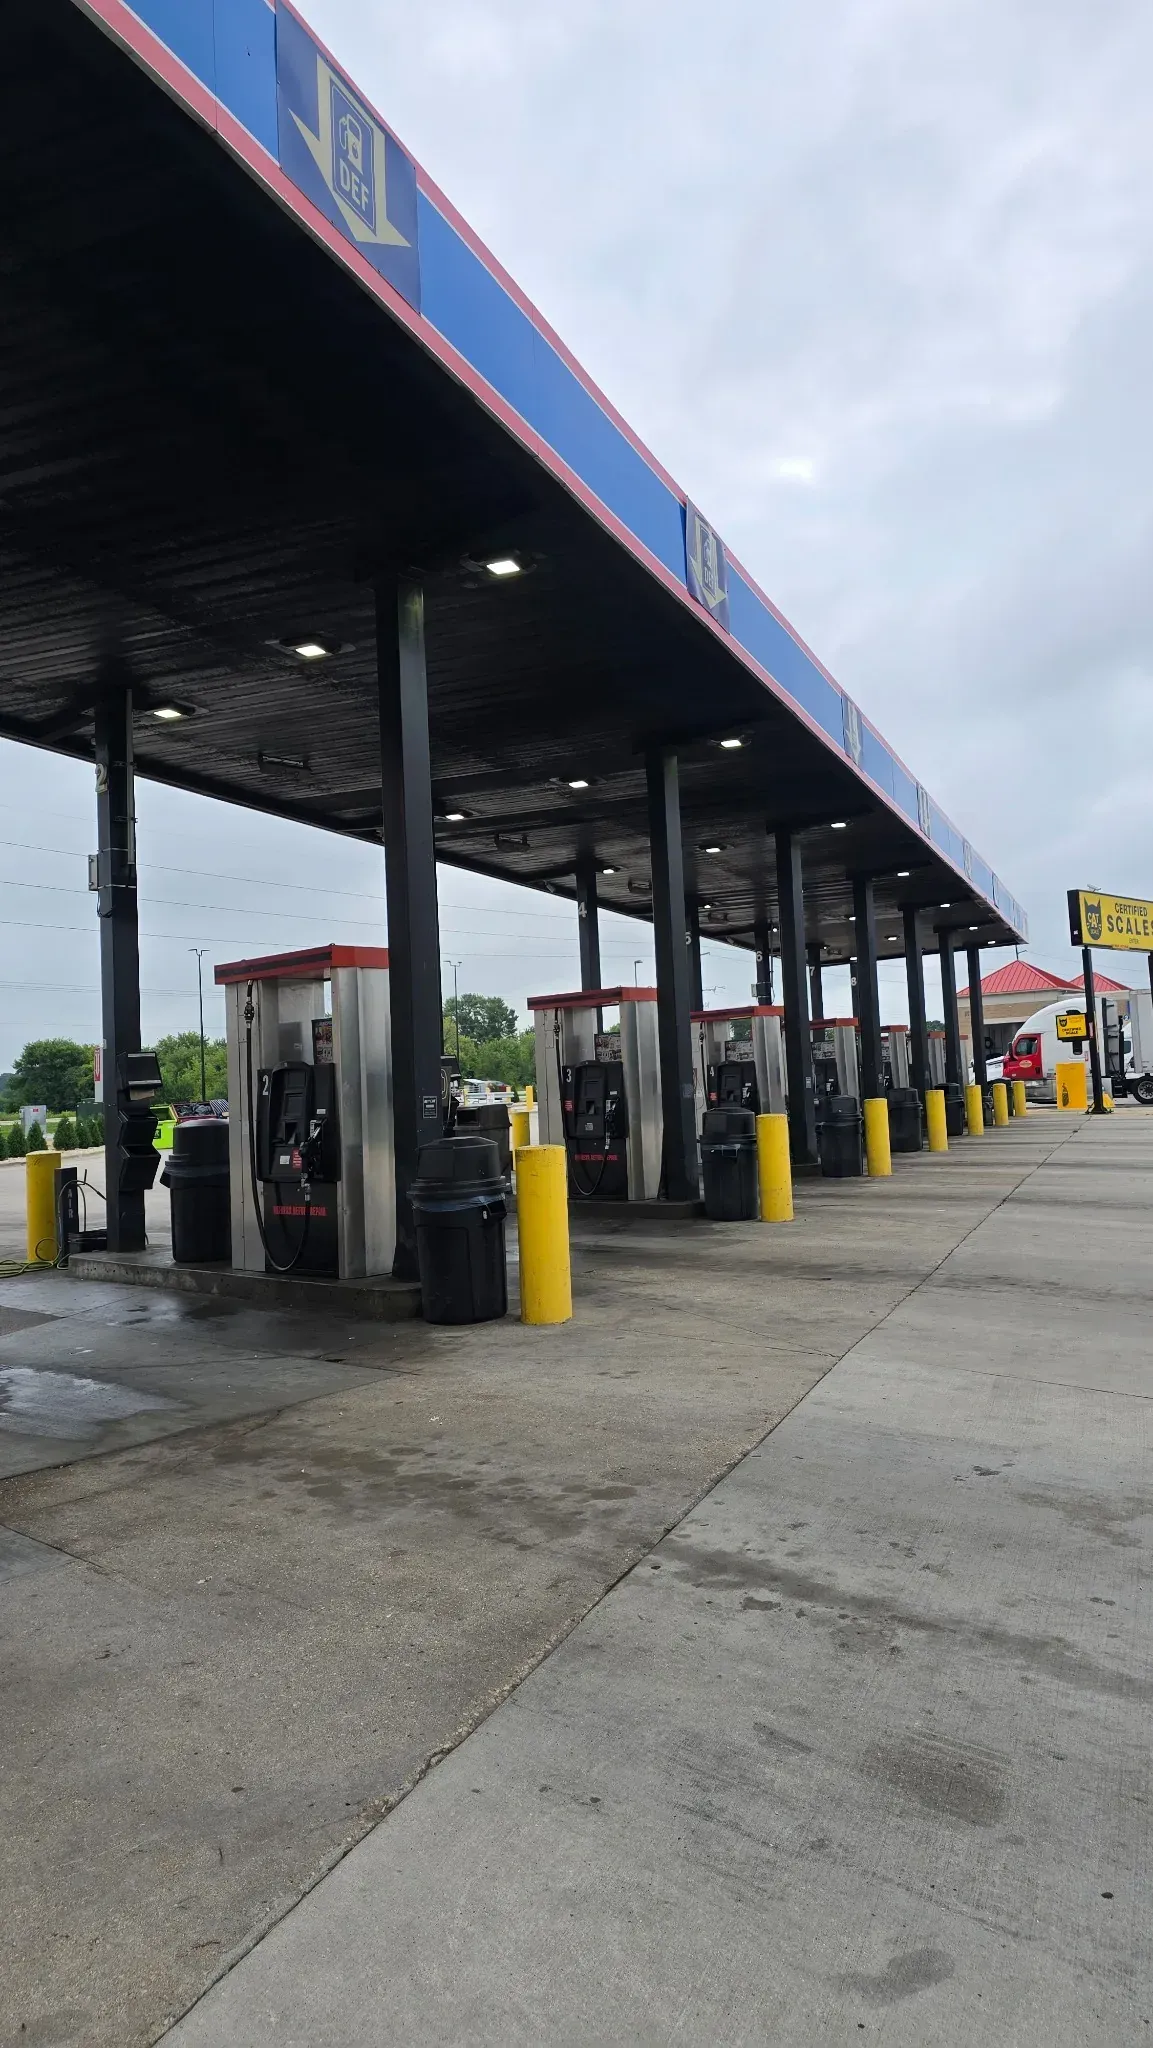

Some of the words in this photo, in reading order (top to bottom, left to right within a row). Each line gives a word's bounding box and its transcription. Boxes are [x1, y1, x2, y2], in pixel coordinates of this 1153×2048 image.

[340, 158, 369, 211] DEF
[95, 763, 107, 793] 2
[579, 902, 587, 918] 4
[1114, 902, 1148, 917] CERTIFIED
[1087, 912, 1099, 928] CAT
[756, 950, 763, 962] 6
[810, 966, 815, 977] 7
[851, 977, 857, 986] 8
[566, 1068, 572, 1083] 3
[262, 1074, 269, 1096] 2
